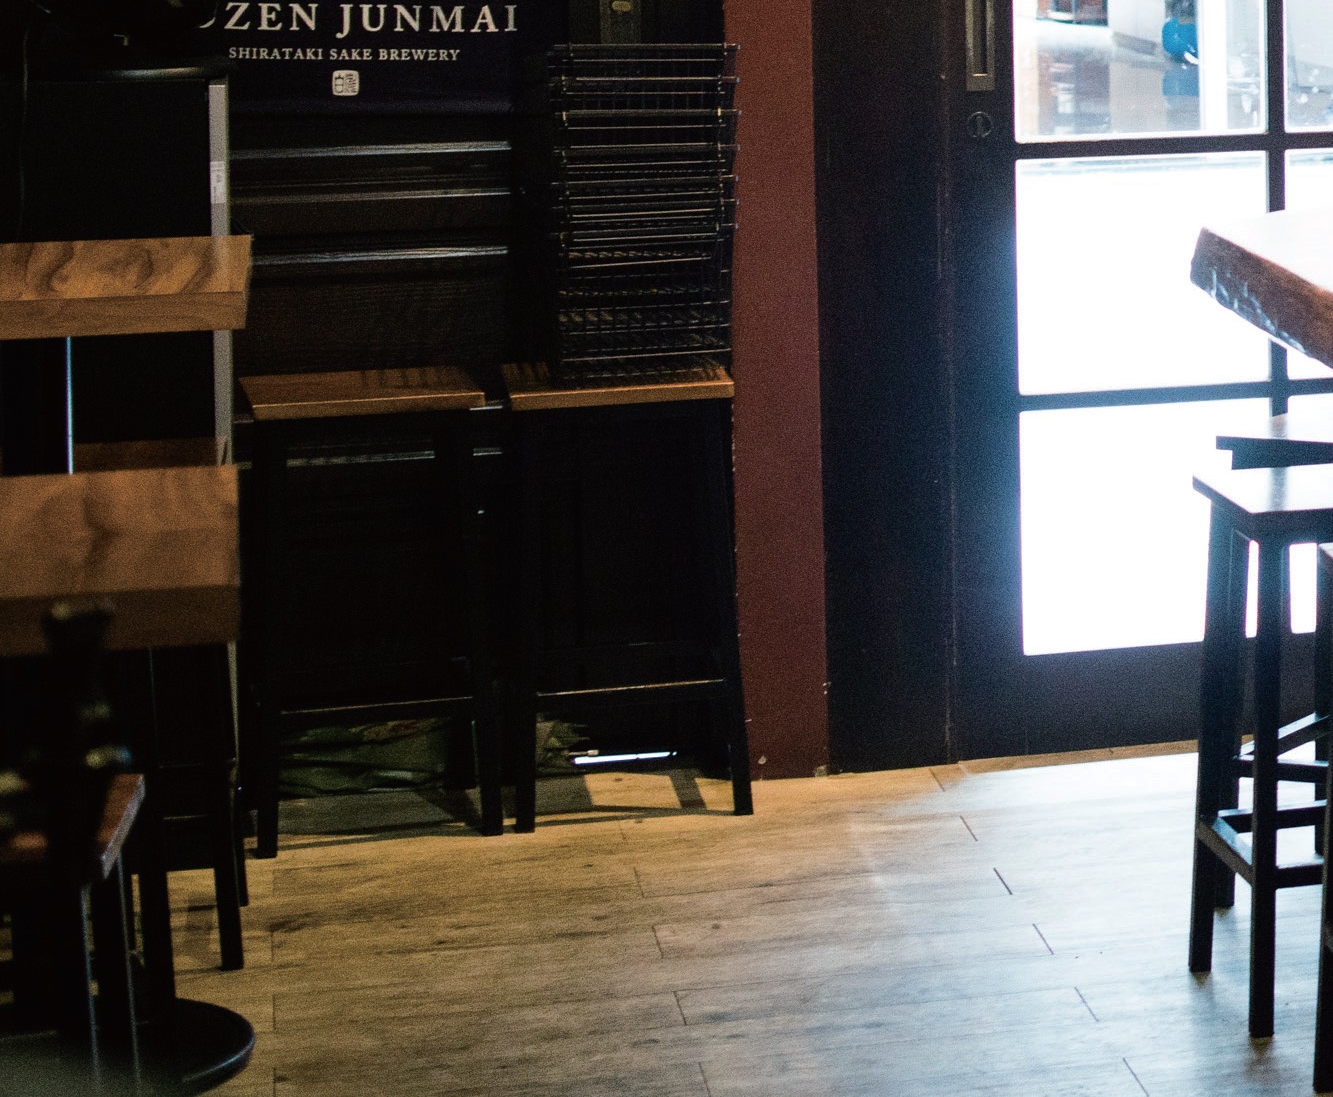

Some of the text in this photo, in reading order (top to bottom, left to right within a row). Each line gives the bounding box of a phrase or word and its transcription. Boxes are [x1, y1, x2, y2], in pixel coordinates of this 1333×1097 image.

[199, 1, 518, 39] ZEN JUNMAI
[228, 46, 461, 61] SHIRATAKI SAKE BREWERY
